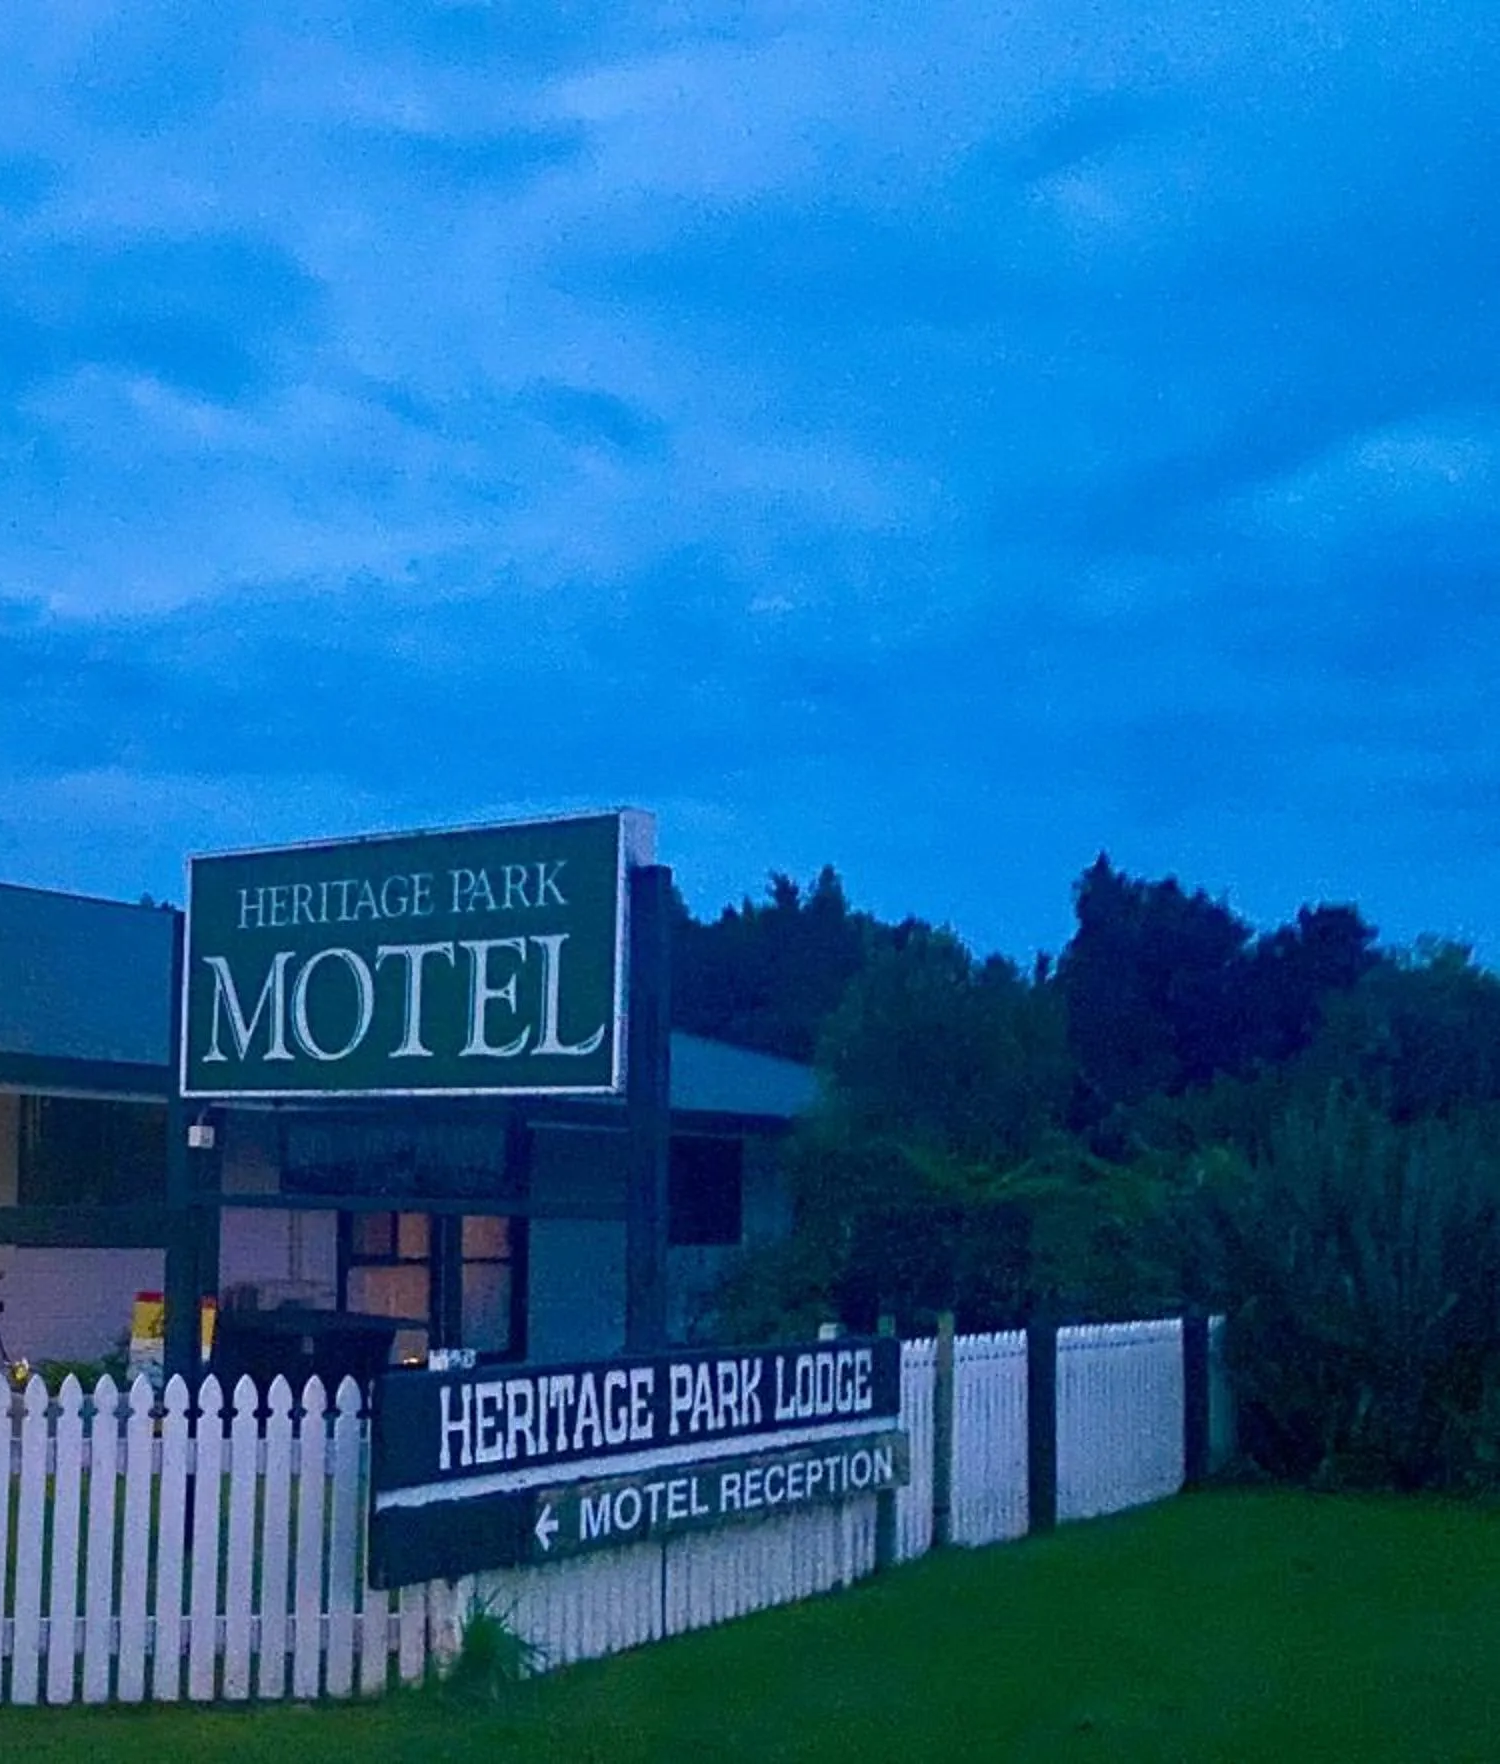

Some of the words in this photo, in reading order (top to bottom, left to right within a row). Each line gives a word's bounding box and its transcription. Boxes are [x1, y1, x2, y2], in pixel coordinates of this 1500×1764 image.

[237, 873, 436, 929] HERITAGE
[448, 860, 569, 913] PARK
[202, 933, 606, 1063] MOTEL
[438, 1366, 655, 1471] HERITAGE
[668, 1356, 763, 1436] PARK
[774, 1348, 873, 1421] LODGE
[579, 1476, 709, 1541] MOTEL
[719, 1446, 894, 1514] RECEPTION
